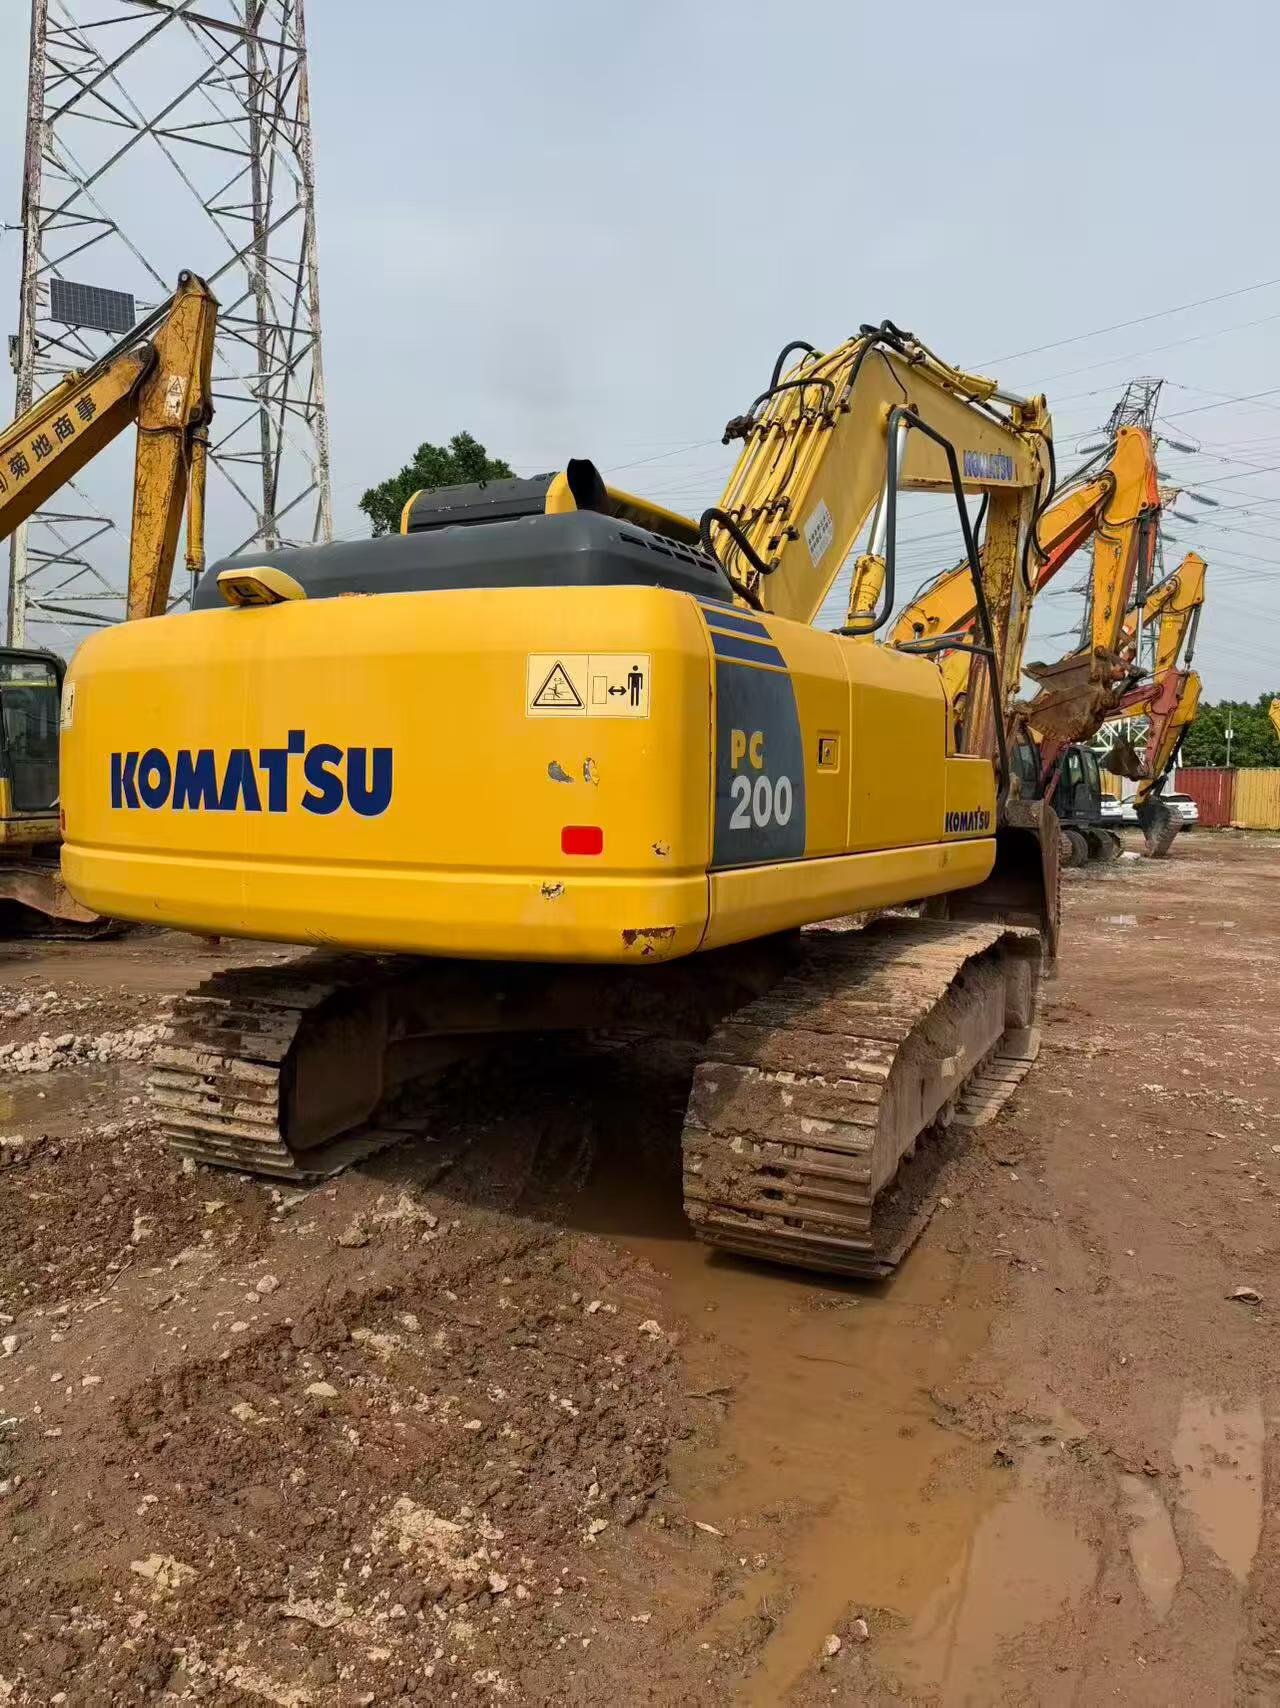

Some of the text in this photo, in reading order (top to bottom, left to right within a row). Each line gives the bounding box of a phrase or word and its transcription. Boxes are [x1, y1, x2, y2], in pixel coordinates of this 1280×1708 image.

[111, 729, 393, 816] KOMATSU
[731, 728, 763, 769] PC
[729, 775, 793, 830] 200
[945, 805, 991, 832] KOMATSU
